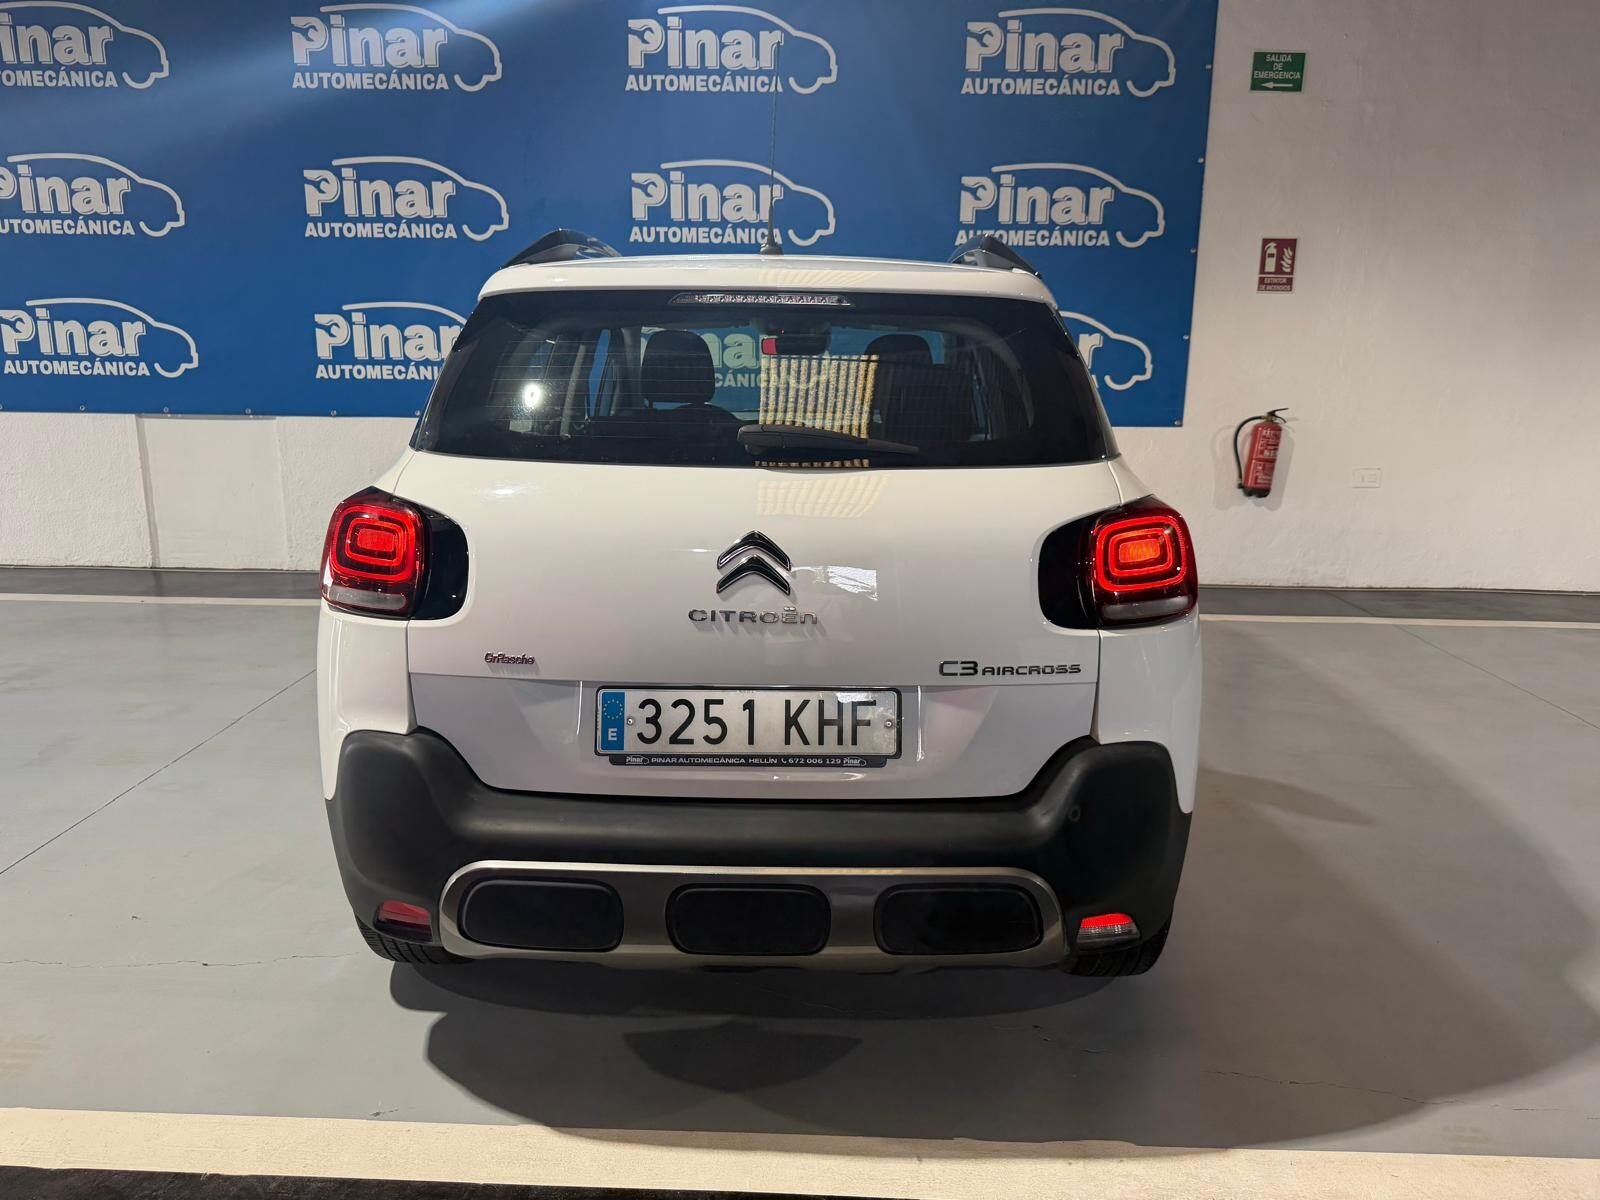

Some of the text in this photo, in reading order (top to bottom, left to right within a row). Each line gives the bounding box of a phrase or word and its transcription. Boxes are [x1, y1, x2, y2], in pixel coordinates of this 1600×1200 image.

[0, 12, 113, 65] inar
[291, 15, 448, 68] Pinar
[628, 16, 784, 70] Pinar
[965, 20, 1124, 73] Pinar
[1265, 54, 1292, 62] SALIDA
[1272, 63, 1284, 71] DE
[0, 67, 118, 87] OMECÁNICA
[292, 70, 448, 90] AUTOMECÁNICA
[625, 71, 783, 92] AUTOMECÁNICA
[960, 74, 1120, 95] AUTOMECÁNICA
[1254, 71, 1301, 80] EMERGENCIA
[303, 168, 456, 218] Pinar
[631, 170, 784, 223] Pinar
[959, 174, 1114, 225] Pinar
[0, 216, 135, 235] UTOMECÁNICA
[305, 219, 457, 238] AUTOMECÁNICA
[0, 309, 146, 356] Pinar
[314, 312, 462, 361] Pinar
[4, 358, 150, 376] AUTOMECÁNICA
[316, 362, 442, 380] AUTOMECÁNI
[939, 660, 1082, 676] C3 AIRCROSS
[607, 698, 877, 746] E 3251 KHF
